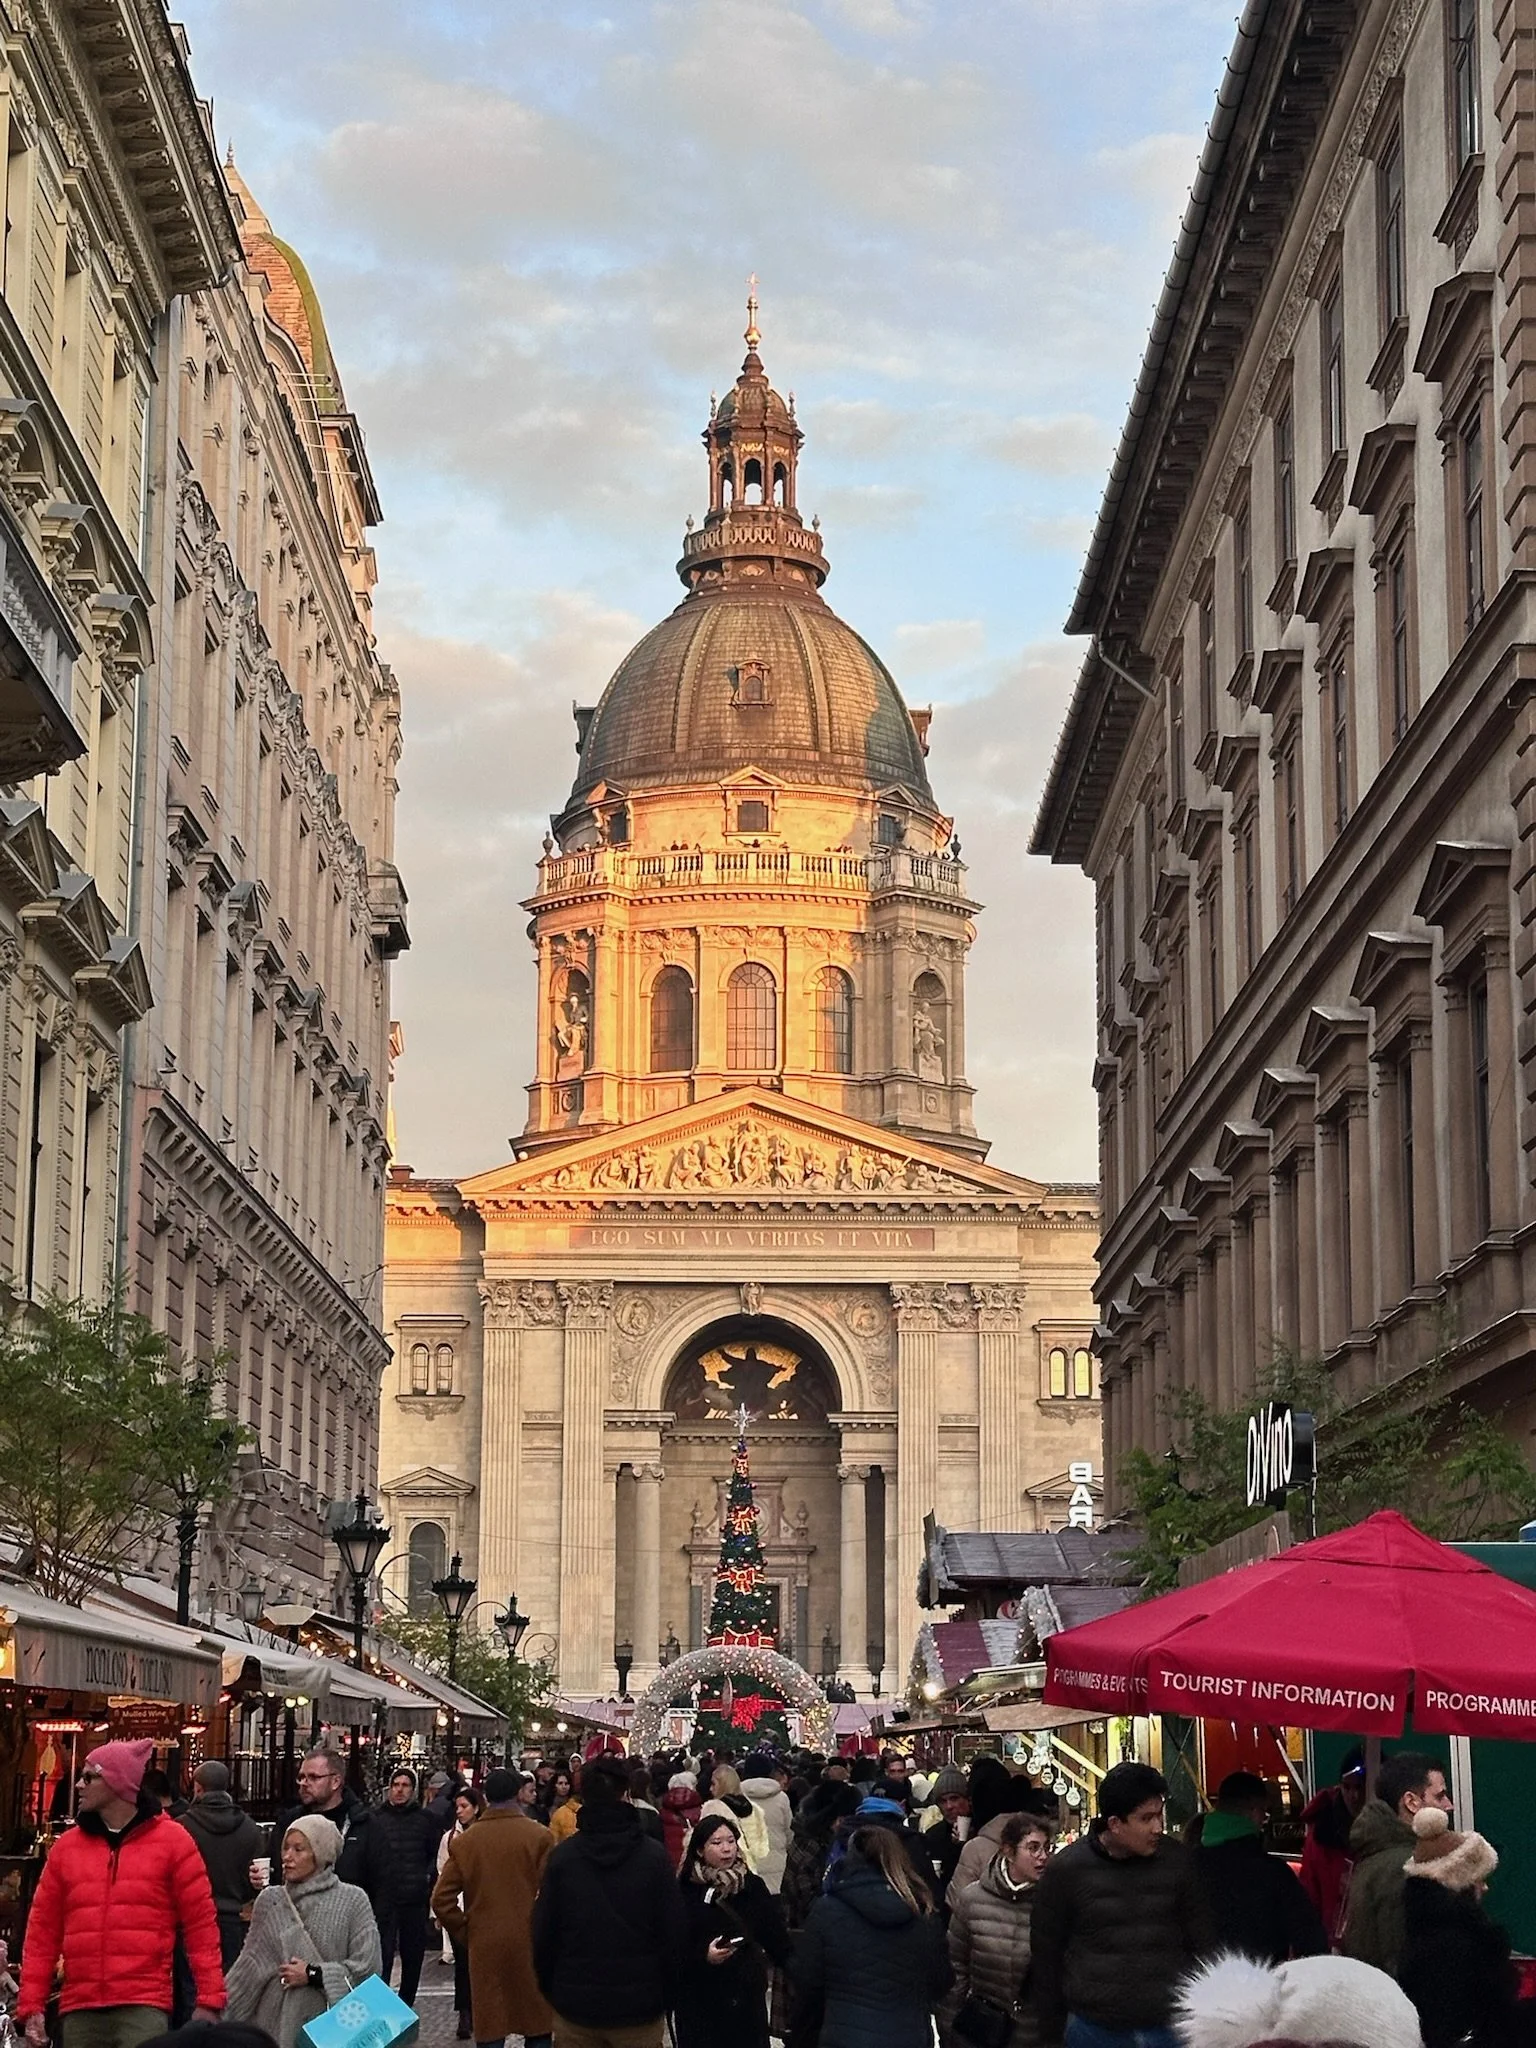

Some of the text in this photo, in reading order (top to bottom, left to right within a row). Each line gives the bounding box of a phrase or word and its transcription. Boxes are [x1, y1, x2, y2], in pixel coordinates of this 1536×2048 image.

[591, 1230, 914, 1247] EGO SUM VIA VERITAS ET VITA
[1101, 1674, 1109, 1691] &
[1160, 1670, 1395, 1712] TOURIST INFORMATION
